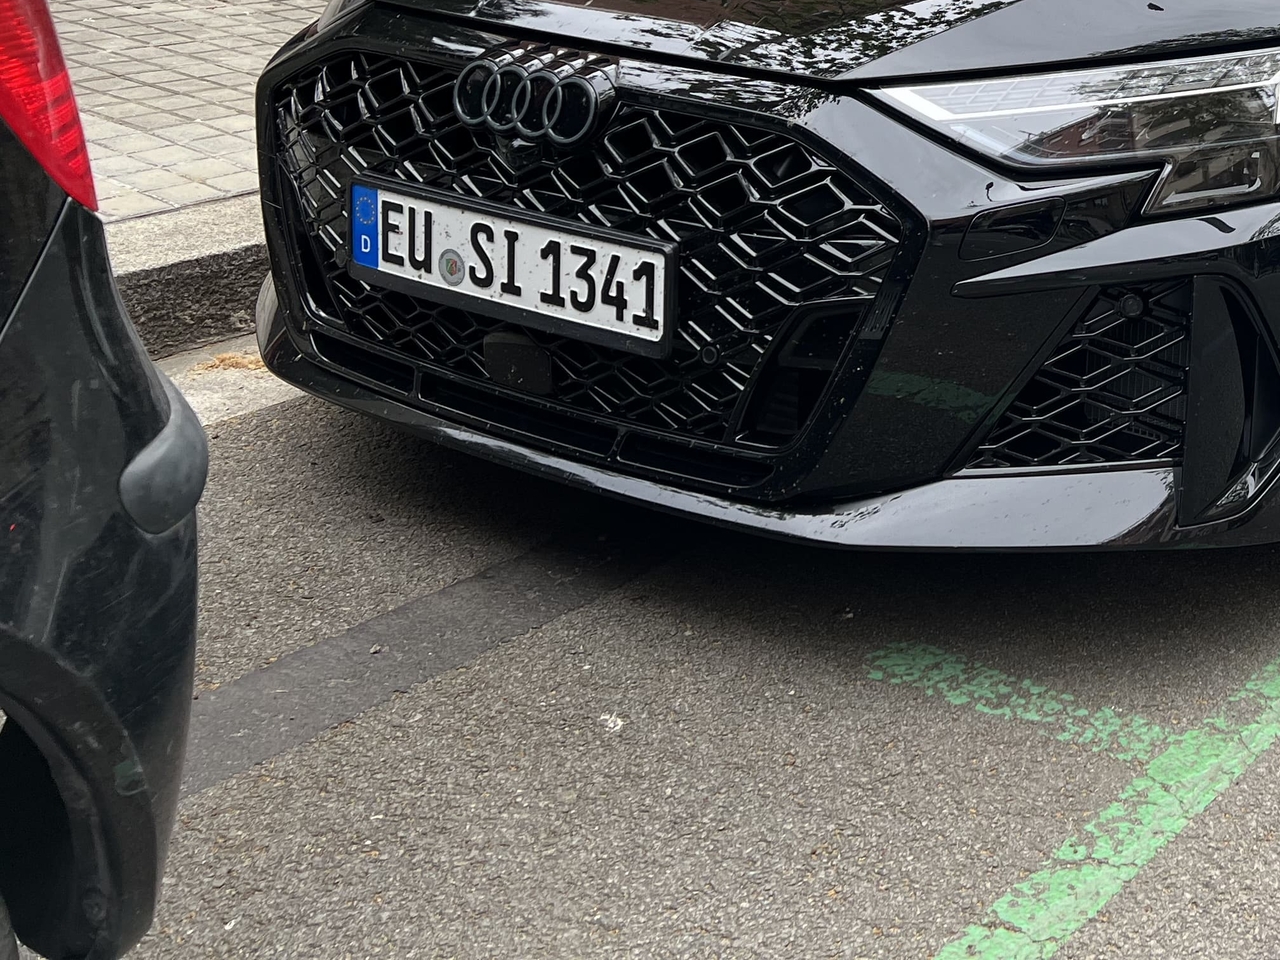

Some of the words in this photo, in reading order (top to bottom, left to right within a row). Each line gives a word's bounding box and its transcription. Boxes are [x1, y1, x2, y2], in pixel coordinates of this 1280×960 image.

[361, 234, 371, 253] D
[381, 199, 433, 274] EU
[468, 221, 522, 297] SI
[540, 239, 660, 331] 1341
